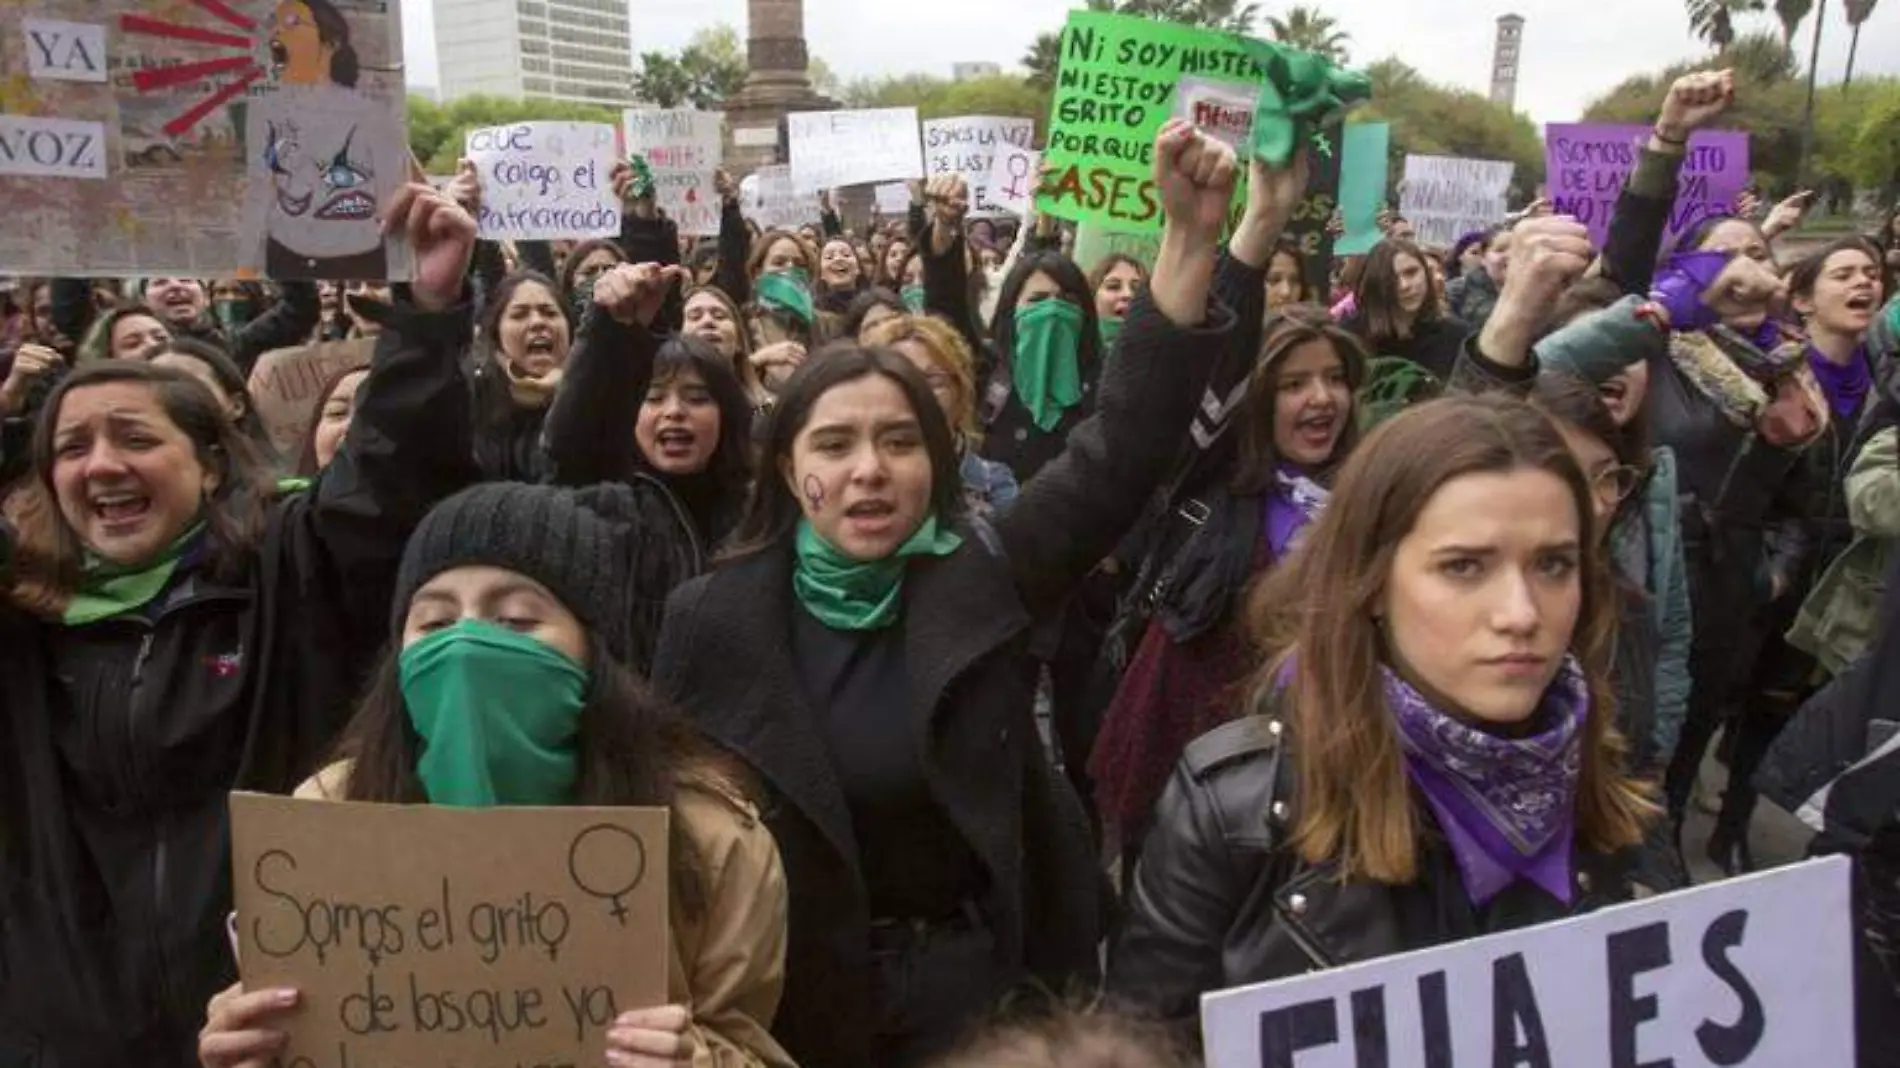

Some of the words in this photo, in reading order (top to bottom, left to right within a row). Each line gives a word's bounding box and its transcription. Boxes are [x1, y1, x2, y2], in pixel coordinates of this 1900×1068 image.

[30, 29, 97, 71] YA
[1116, 38, 1176, 68] SOY
[1058, 98, 1146, 127] GRITO
[0, 129, 97, 168] VOZ
[978, 129, 997, 145] LA
[1556, 137, 1634, 165] SOMOS
[573, 158, 597, 189] el
[1561, 168, 1587, 191] DE
[1553, 196, 1593, 225] NO
[253, 849, 404, 967] Somos
[416, 875, 455, 952] el
[468, 891, 570, 965] grito
[1606, 908, 1766, 1068] ES
[340, 974, 399, 1035] de
